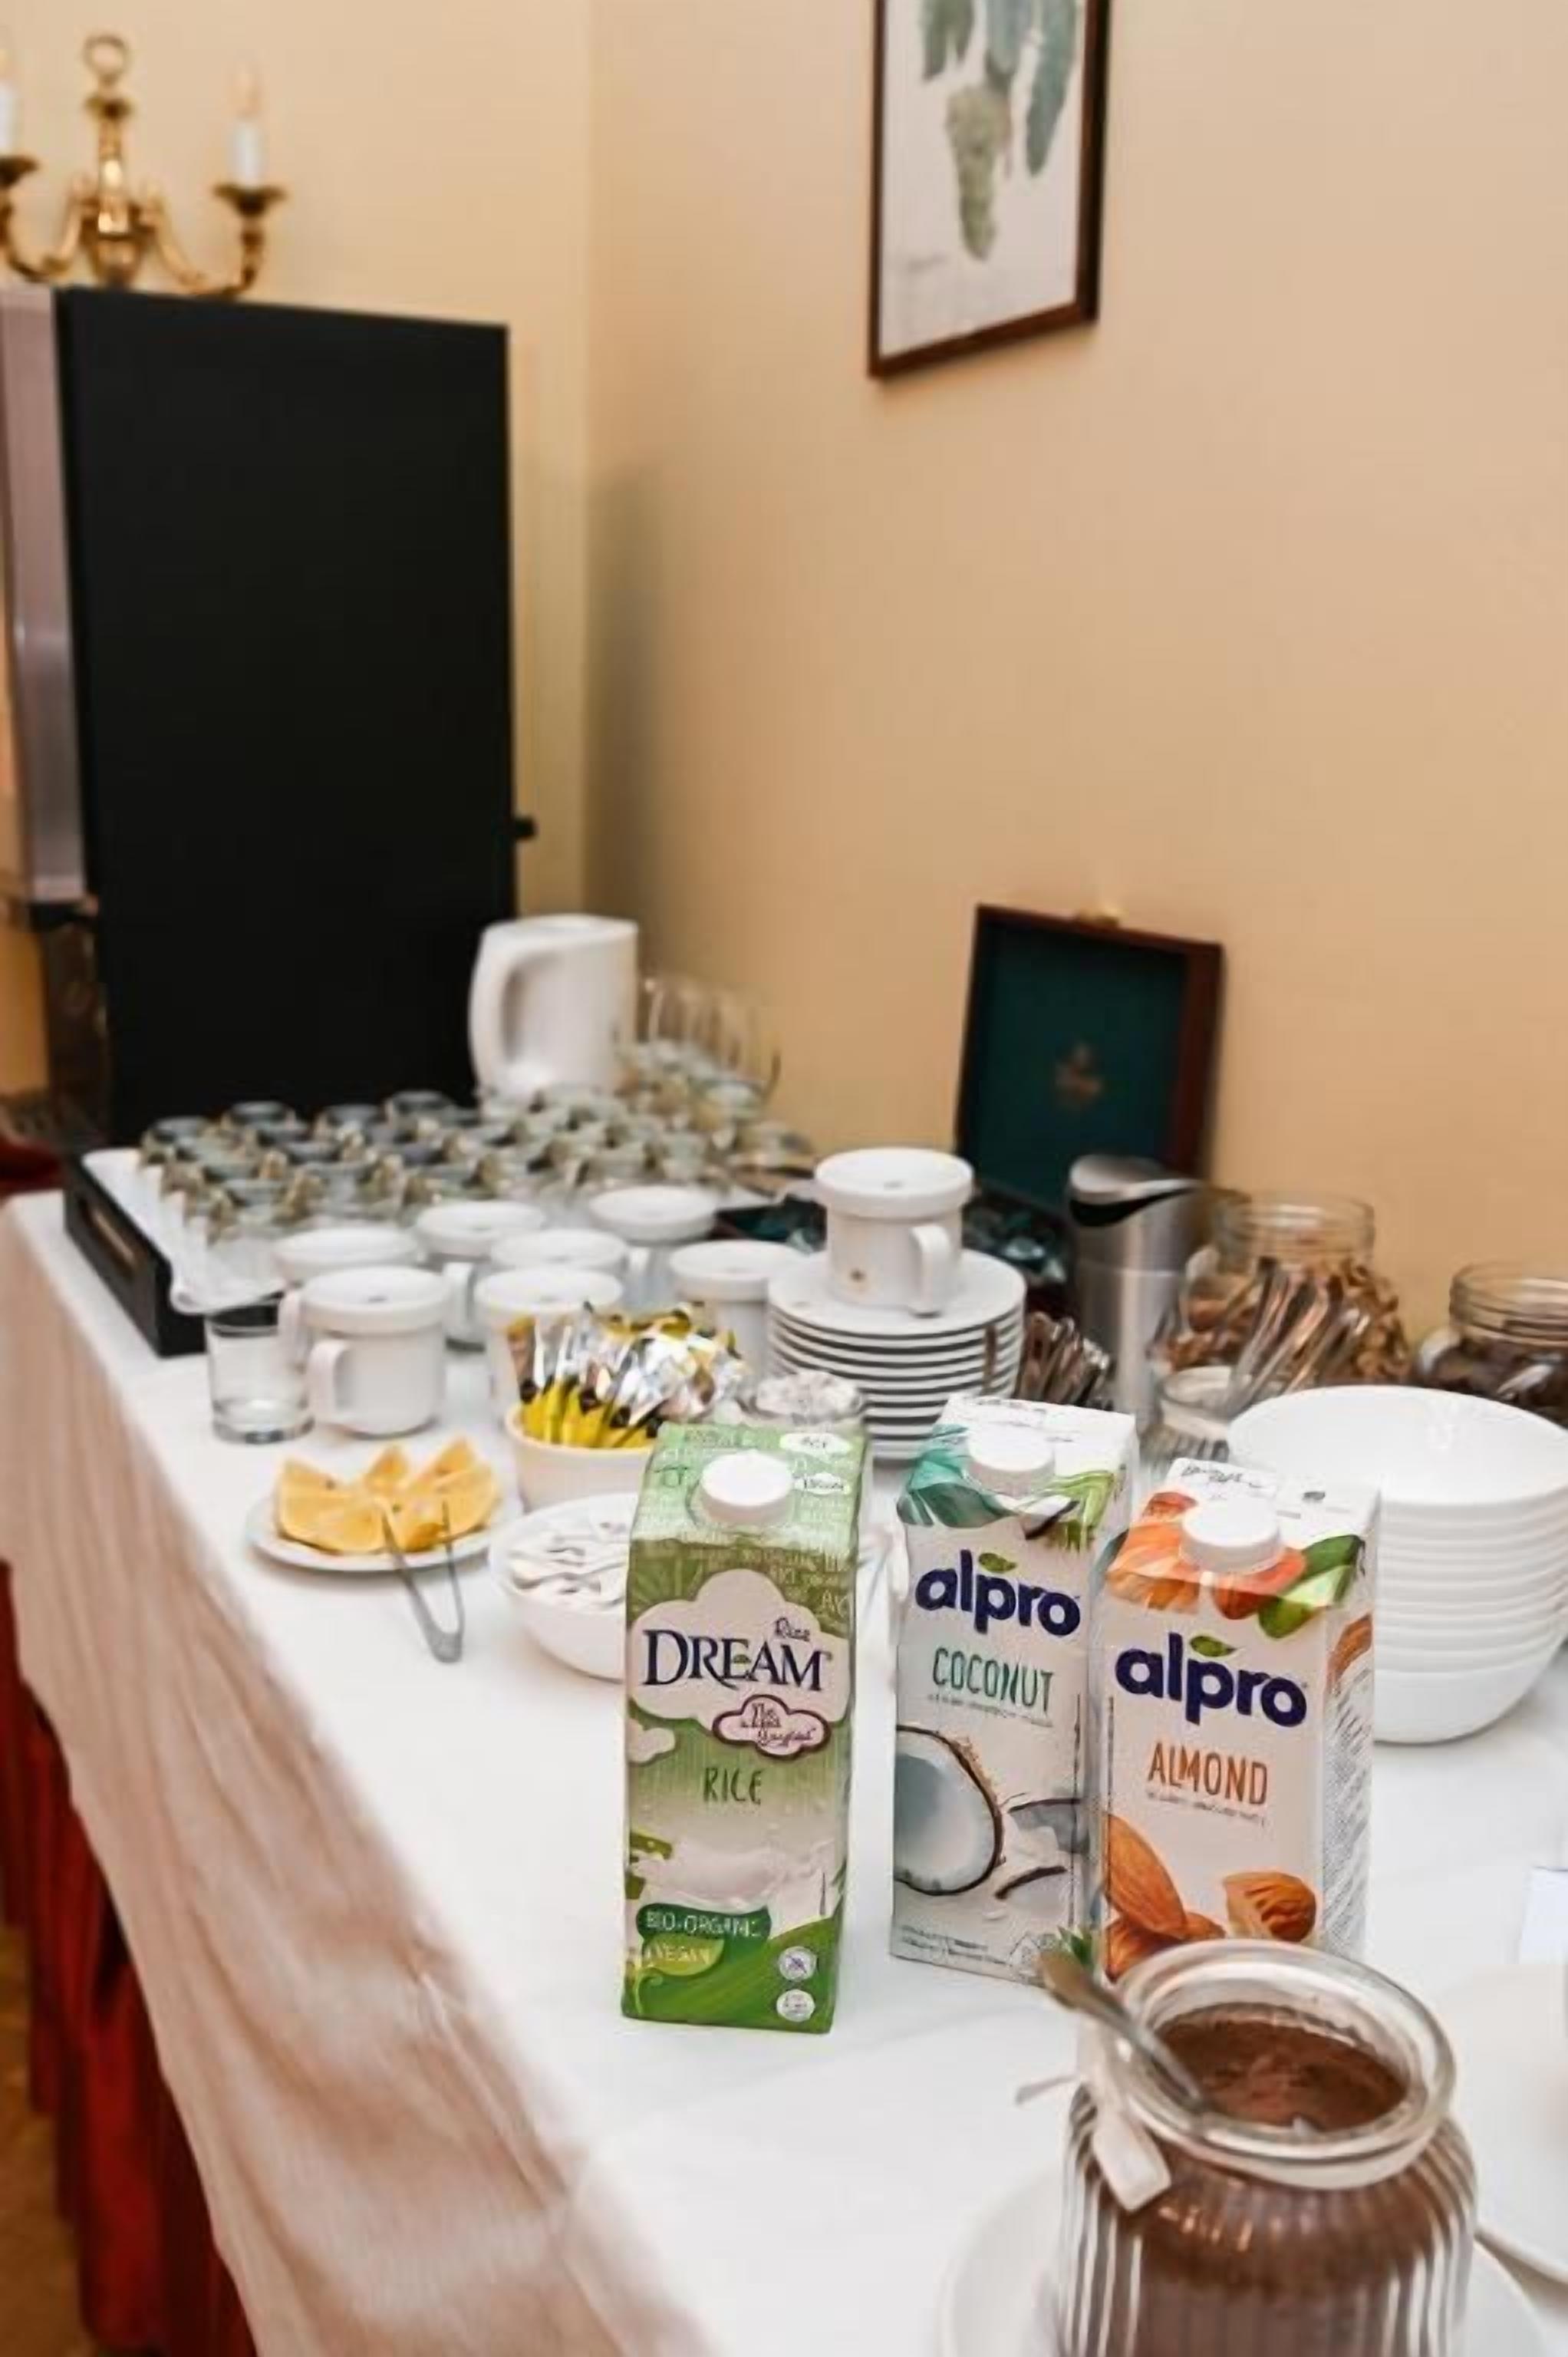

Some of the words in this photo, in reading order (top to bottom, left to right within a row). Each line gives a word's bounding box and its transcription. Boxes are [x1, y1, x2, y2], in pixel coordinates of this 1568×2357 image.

[915, 1550, 1081, 1637] alpro
[643, 1630, 832, 1691] DREAM
[932, 1647, 1054, 1713] COCONUT
[1115, 1632, 1307, 1728] alpro
[703, 1767, 762, 1805] RICE
[1147, 1741, 1268, 1806] ALMOND
